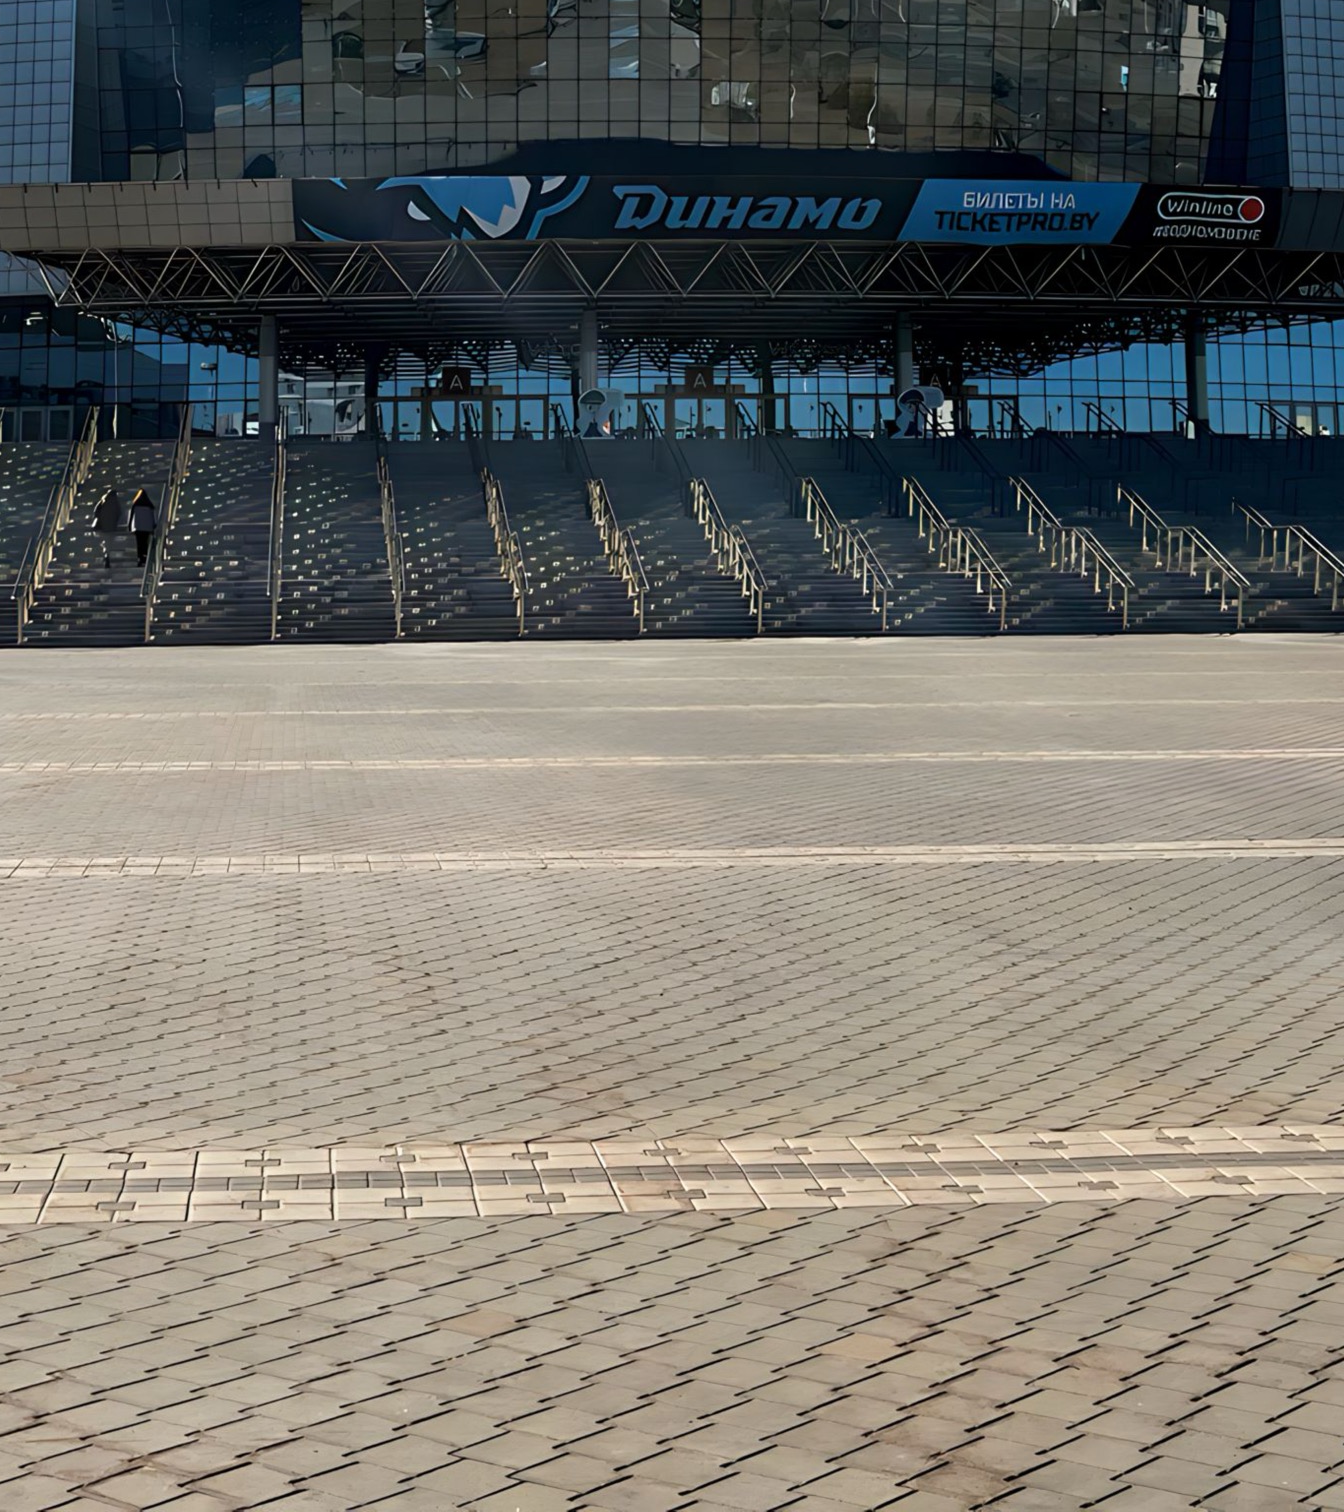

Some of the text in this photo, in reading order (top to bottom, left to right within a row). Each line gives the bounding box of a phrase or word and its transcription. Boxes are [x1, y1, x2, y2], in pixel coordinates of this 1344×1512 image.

[963, 191, 1076, 209] БИЛЕТЫ НА
[934, 210, 1100, 232] TICKETPRO.BY
